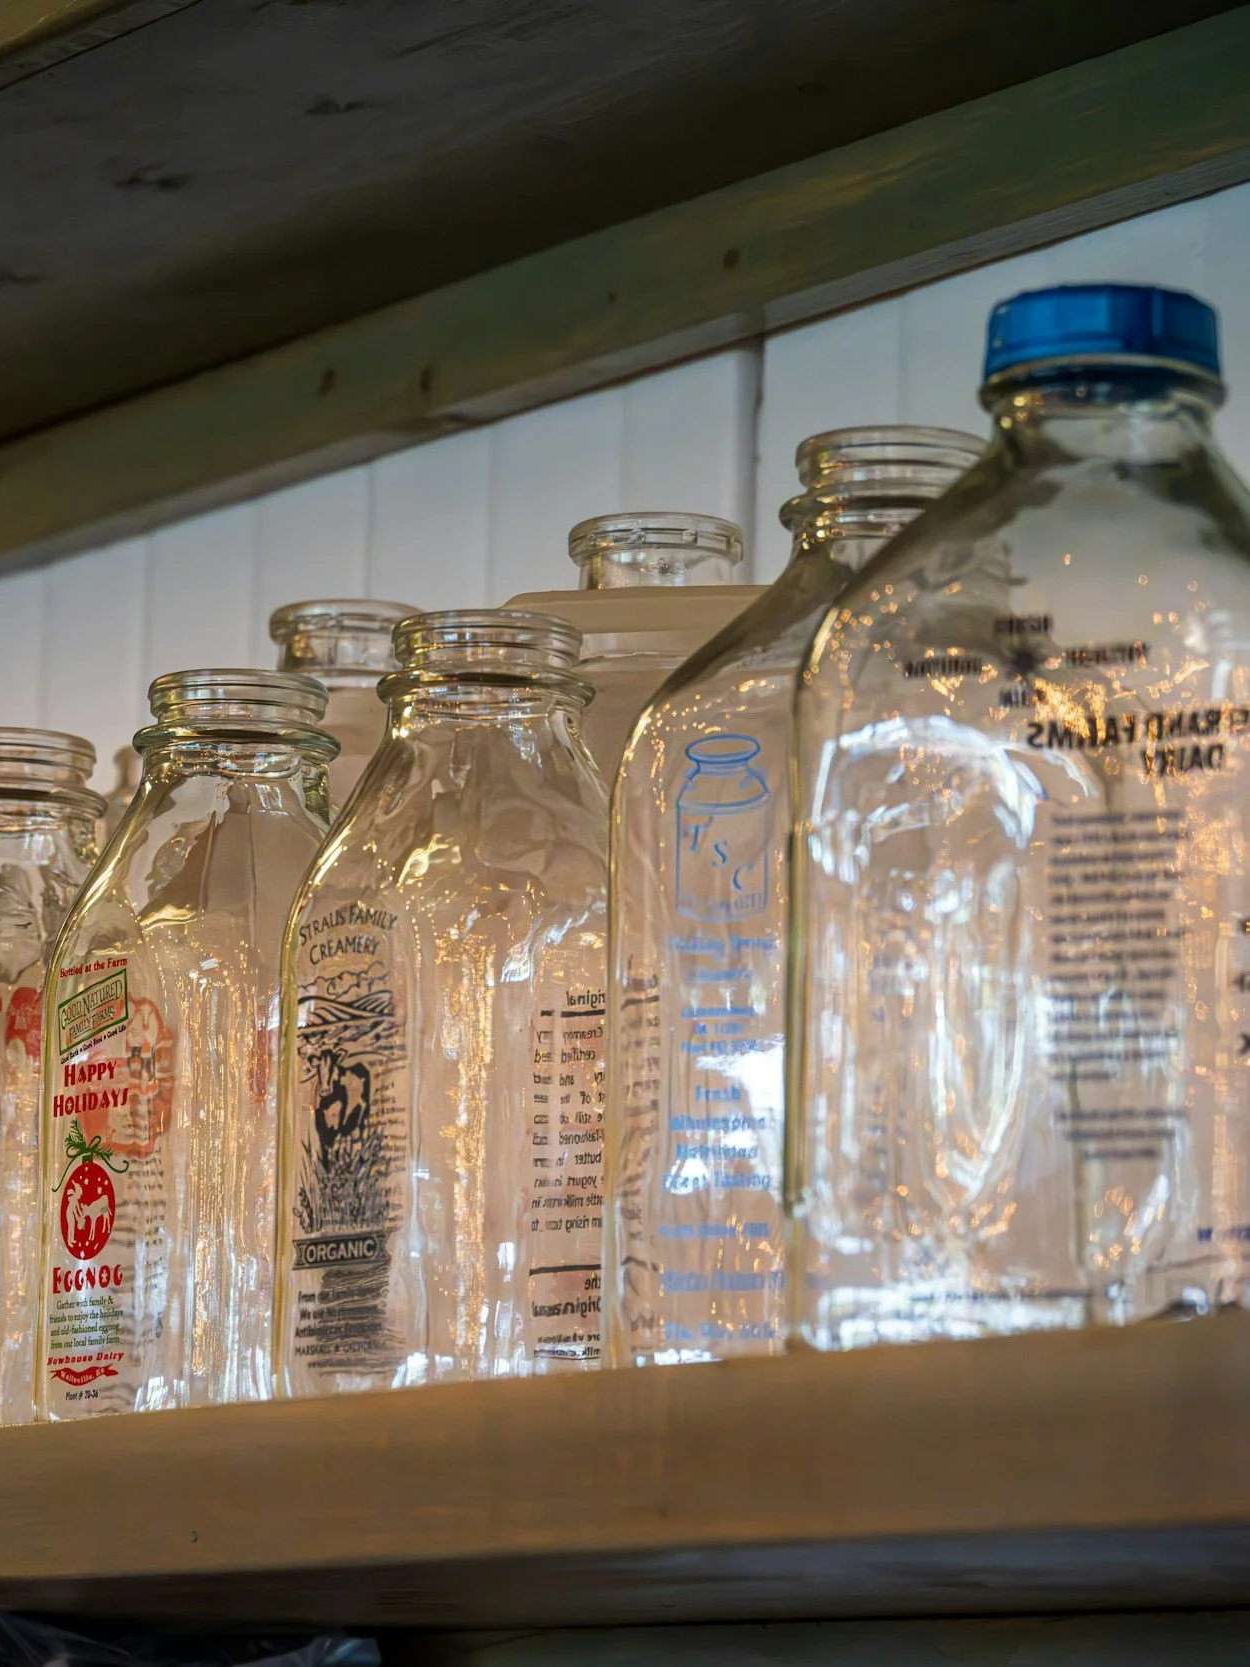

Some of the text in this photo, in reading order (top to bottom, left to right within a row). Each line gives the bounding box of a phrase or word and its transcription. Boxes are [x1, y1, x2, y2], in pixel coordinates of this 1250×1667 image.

[299, 903, 398, 946] STRAUS FAMILY
[310, 934, 380, 965] CREAMERY
[60, 957, 128, 978] Bottled at the Farm
[61, 979, 123, 1030] GOOD NATURED
[69, 1015, 92, 1038] FAMILY
[64, 1060, 117, 1087] HAPPY
[53, 1088, 129, 1117] HOLIDAYS
[306, 1240, 375, 1263] ORGANIC
[53, 1264, 123, 1294] EGGNOG
[57, 1295, 114, 1309] Gather with family &
[49, 1313, 67, 1323] friends
[74, 1311, 89, 1323] enjoy
[90, 1309, 99, 1319] the
[100, 1308, 123, 1320] holidays
[51, 1322, 120, 1336] and old-fashioned eggnog
[51, 1340, 63, 1349] from
[74, 1336, 87, 1347] local
[88, 1336, 106, 1349] family
[106, 1334, 120, 1344] farm
[96, 1351, 124, 1362] Dairy
[65, 1391, 77, 1401] Plant
